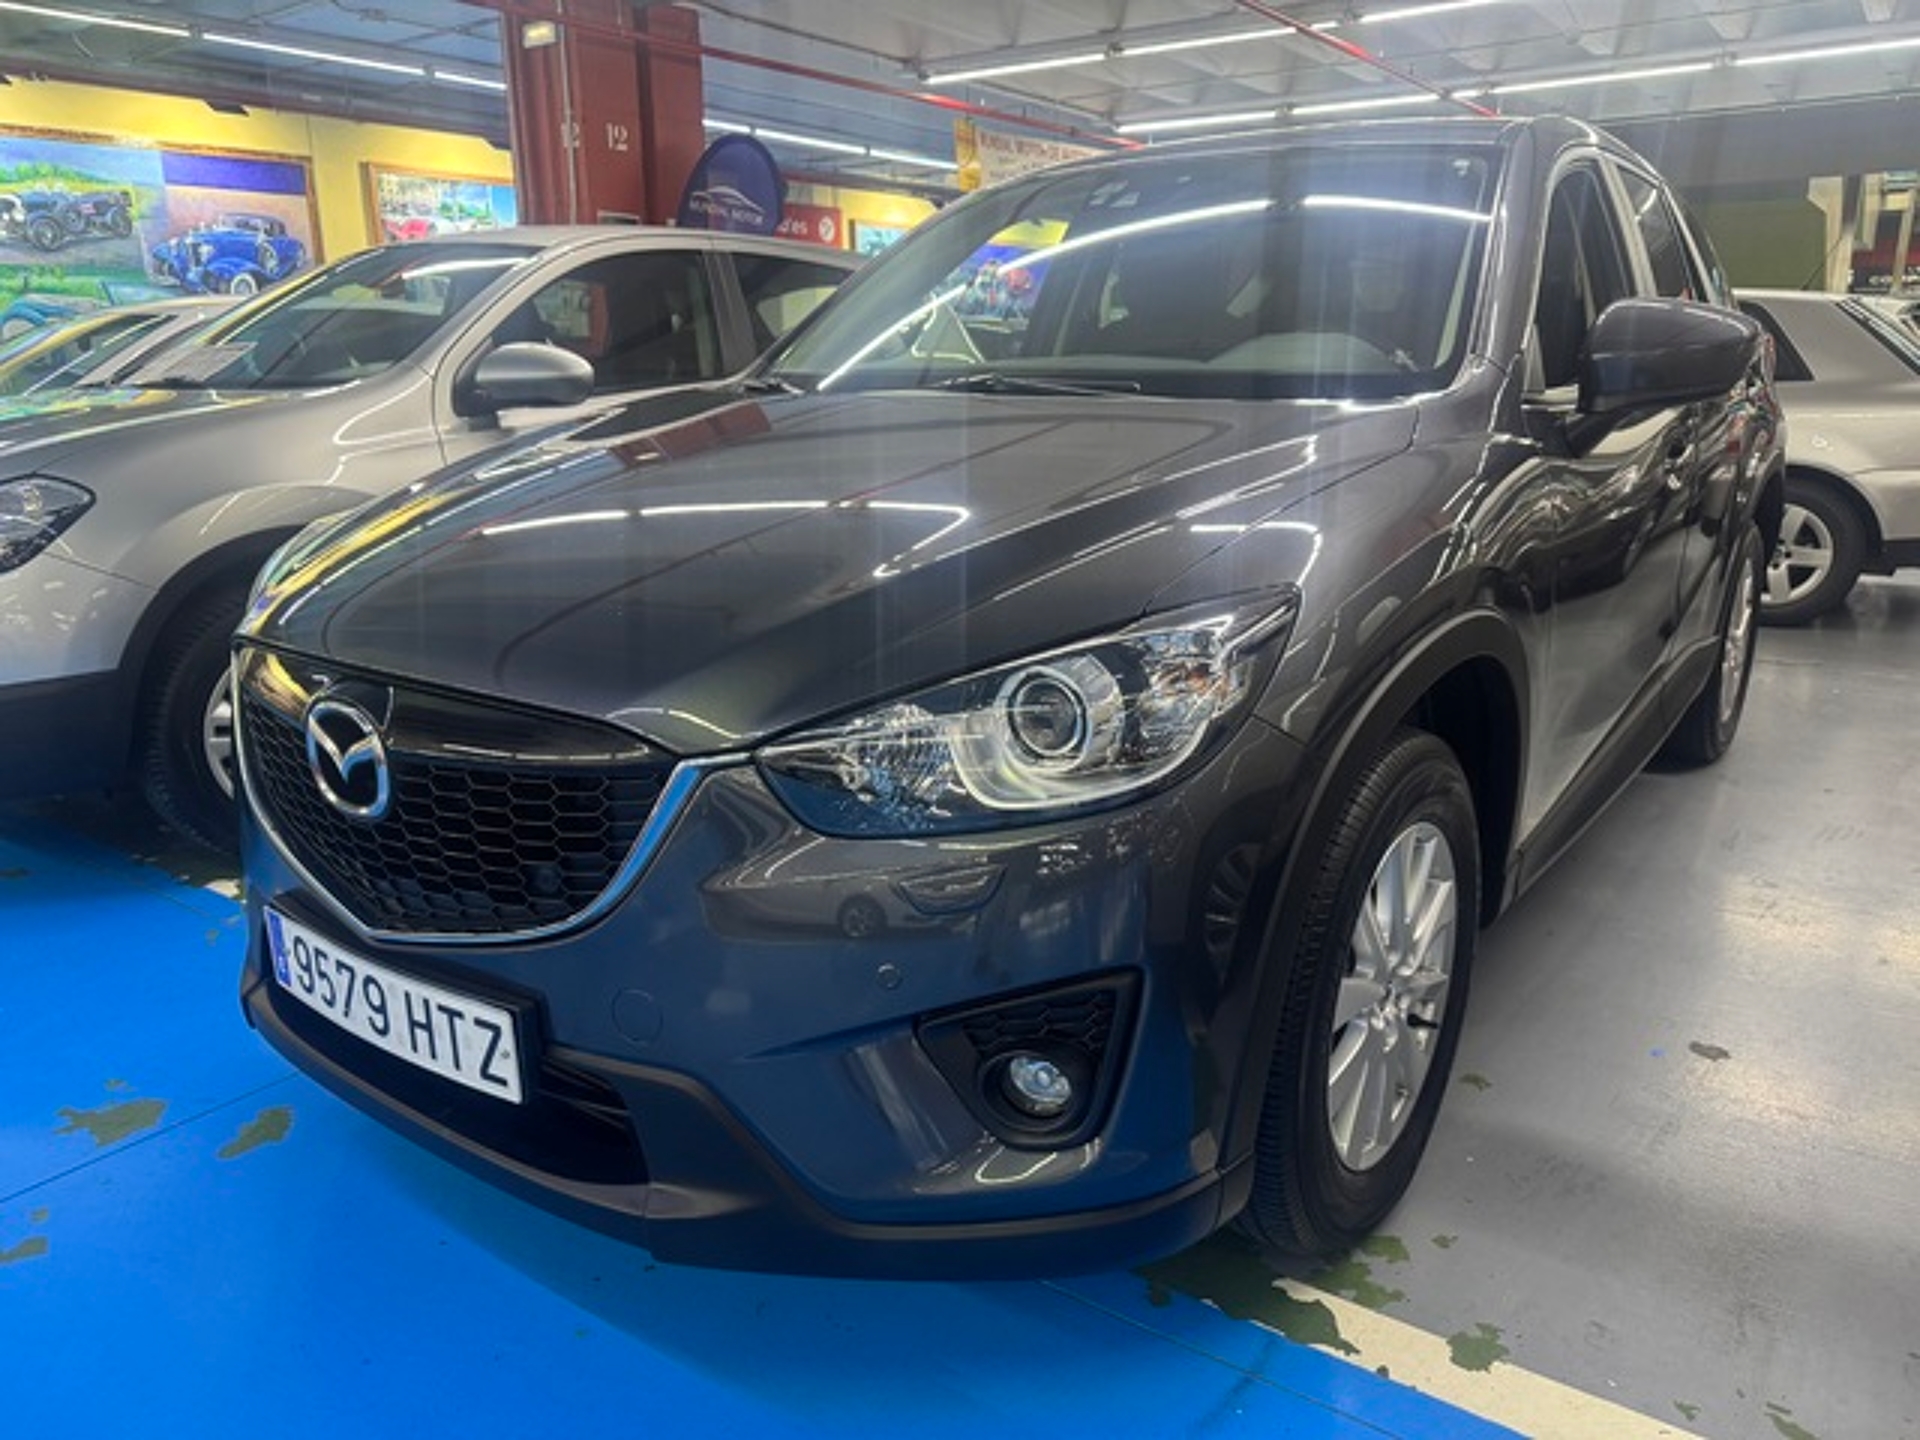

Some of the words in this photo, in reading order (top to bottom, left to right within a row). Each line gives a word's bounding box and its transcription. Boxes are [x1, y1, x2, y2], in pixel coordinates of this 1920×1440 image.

[605, 122, 629, 151] 12
[293, 935, 391, 1037] 9579
[404, 989, 508, 1087] HTZ
